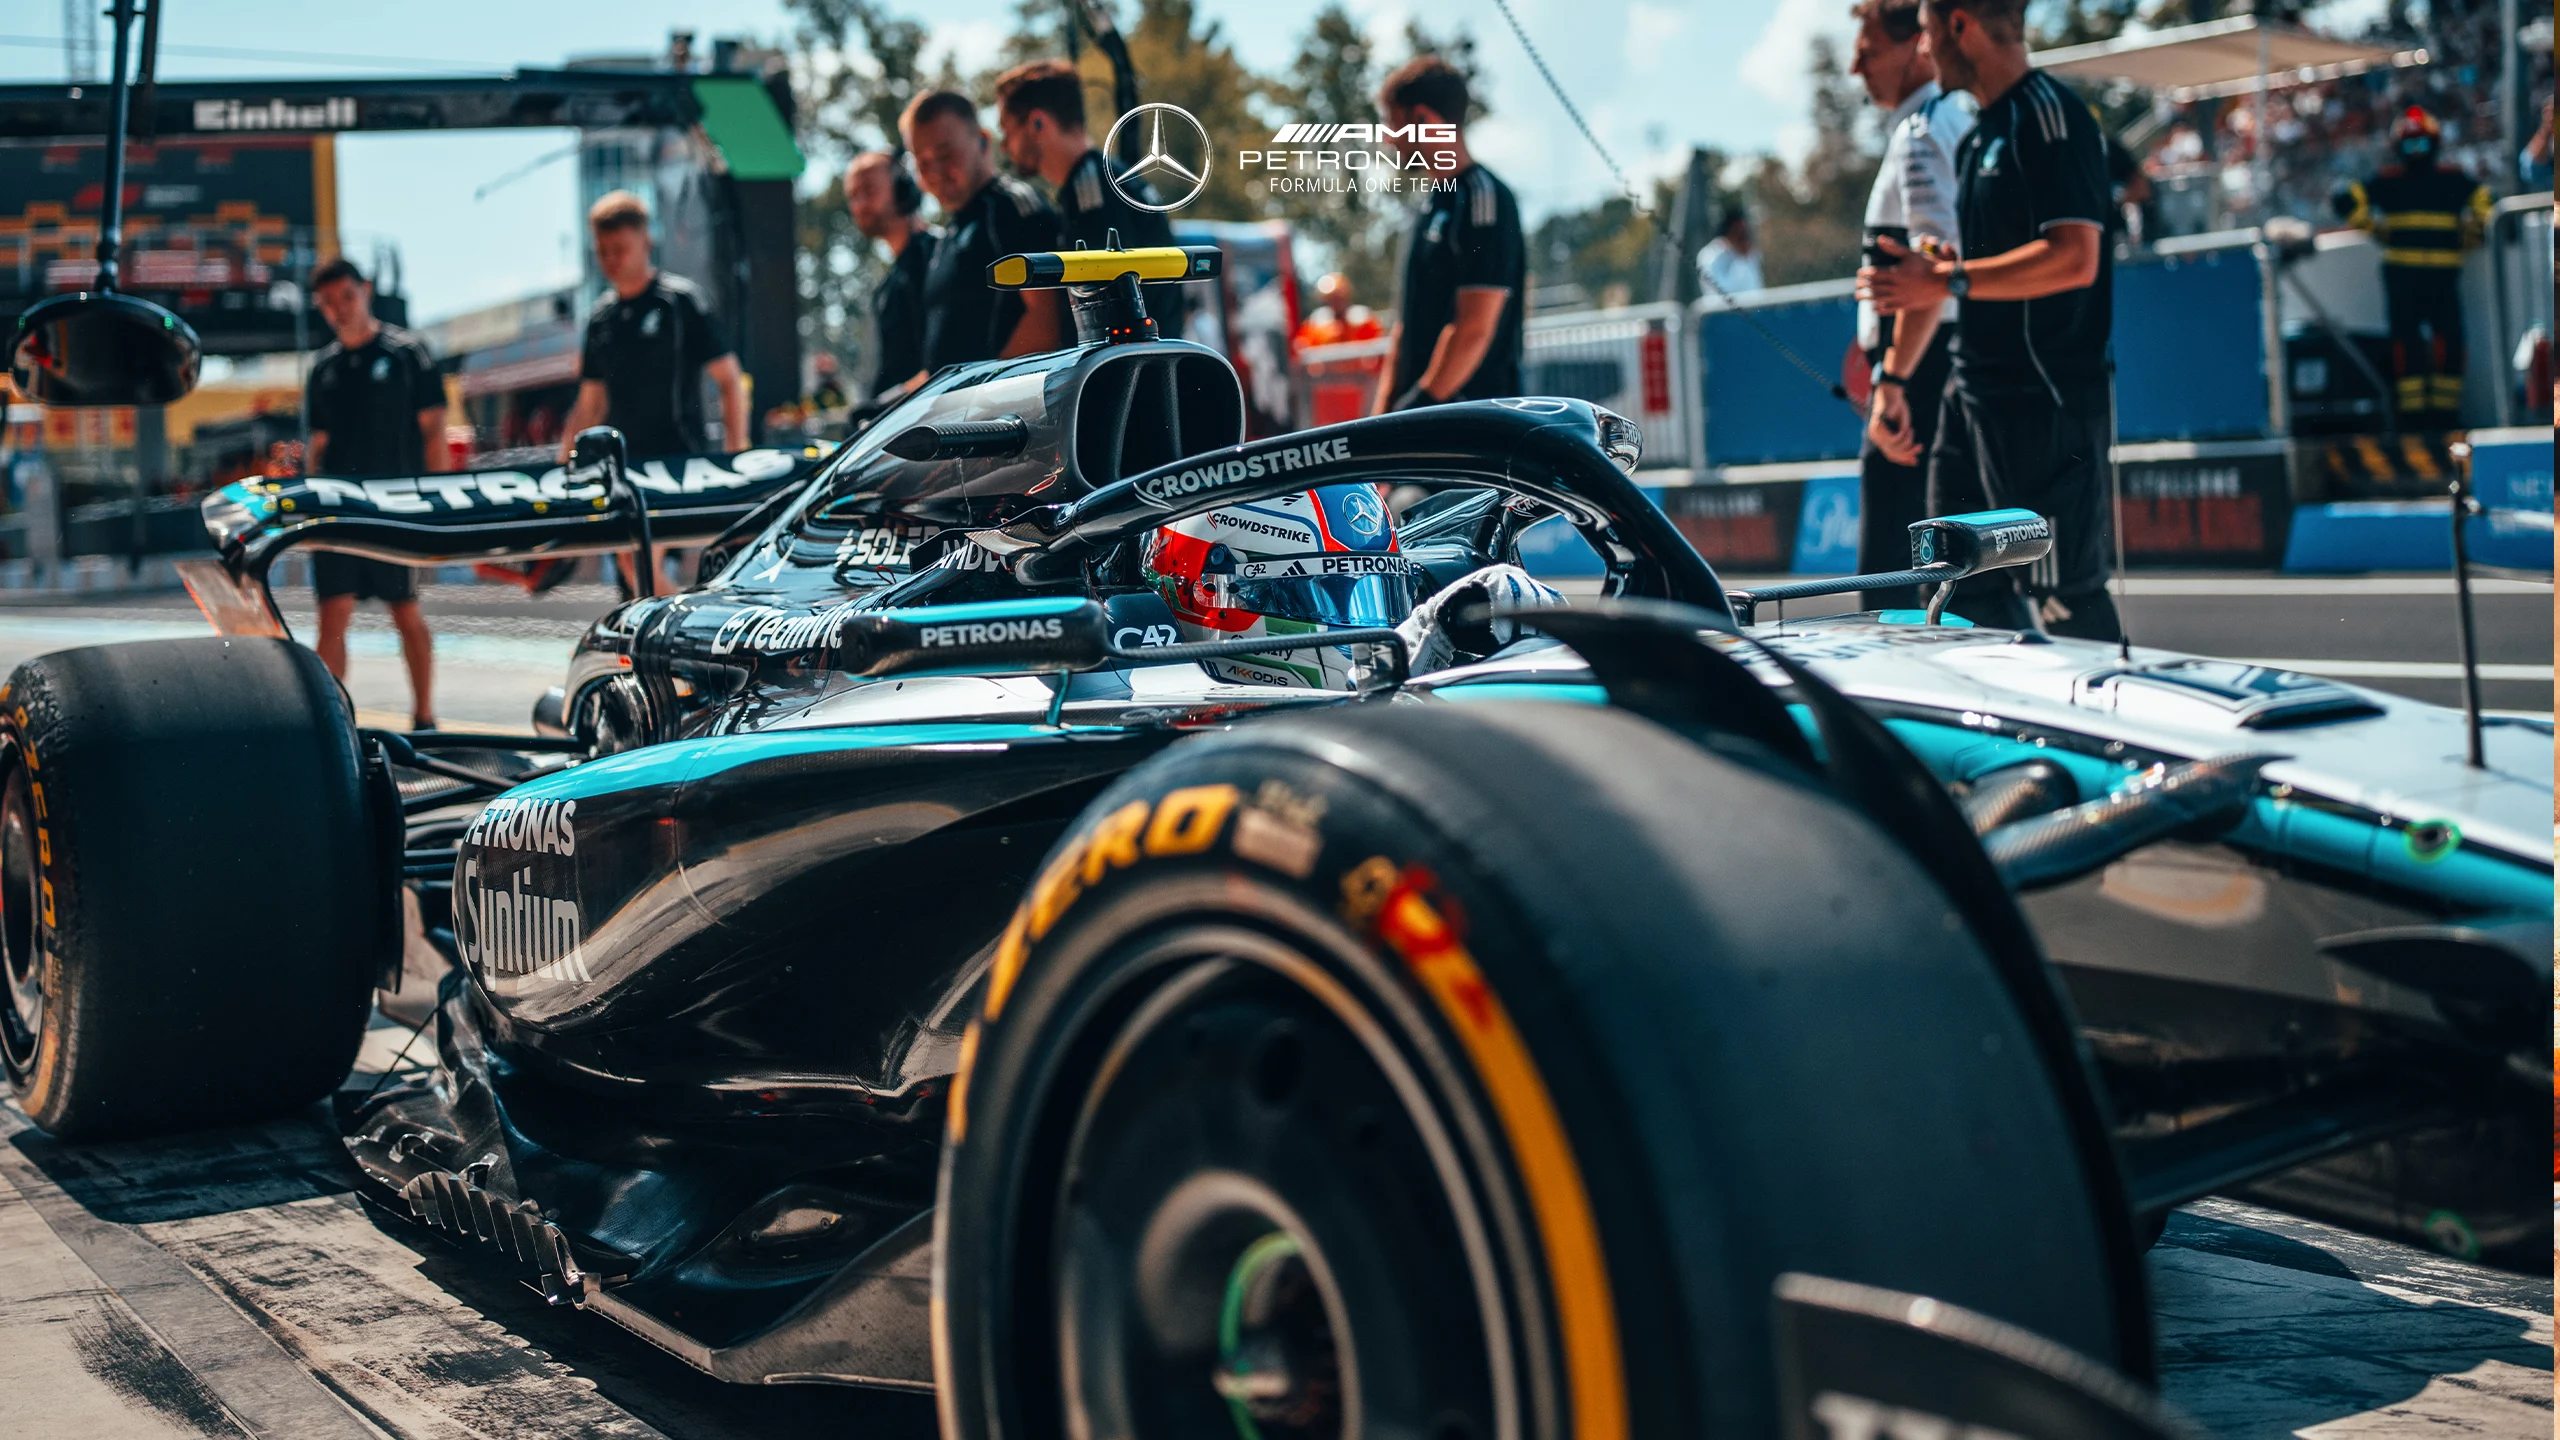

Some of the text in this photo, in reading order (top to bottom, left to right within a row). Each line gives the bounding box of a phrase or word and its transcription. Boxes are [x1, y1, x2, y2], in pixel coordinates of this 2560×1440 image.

[193, 98, 358, 130] Einhell
[305, 448, 796, 513] PETRONAS
[1146, 436, 1352, 500] CROWDSTRIKE
[1212, 512, 1311, 544] CROWDSTRIKE
[1991, 521, 2050, 546] PETRONAS
[1243, 556, 1409, 579] G42 PETRONAS
[920, 618, 1063, 648] PETRONAS
[465, 858, 593, 993] Syntium
